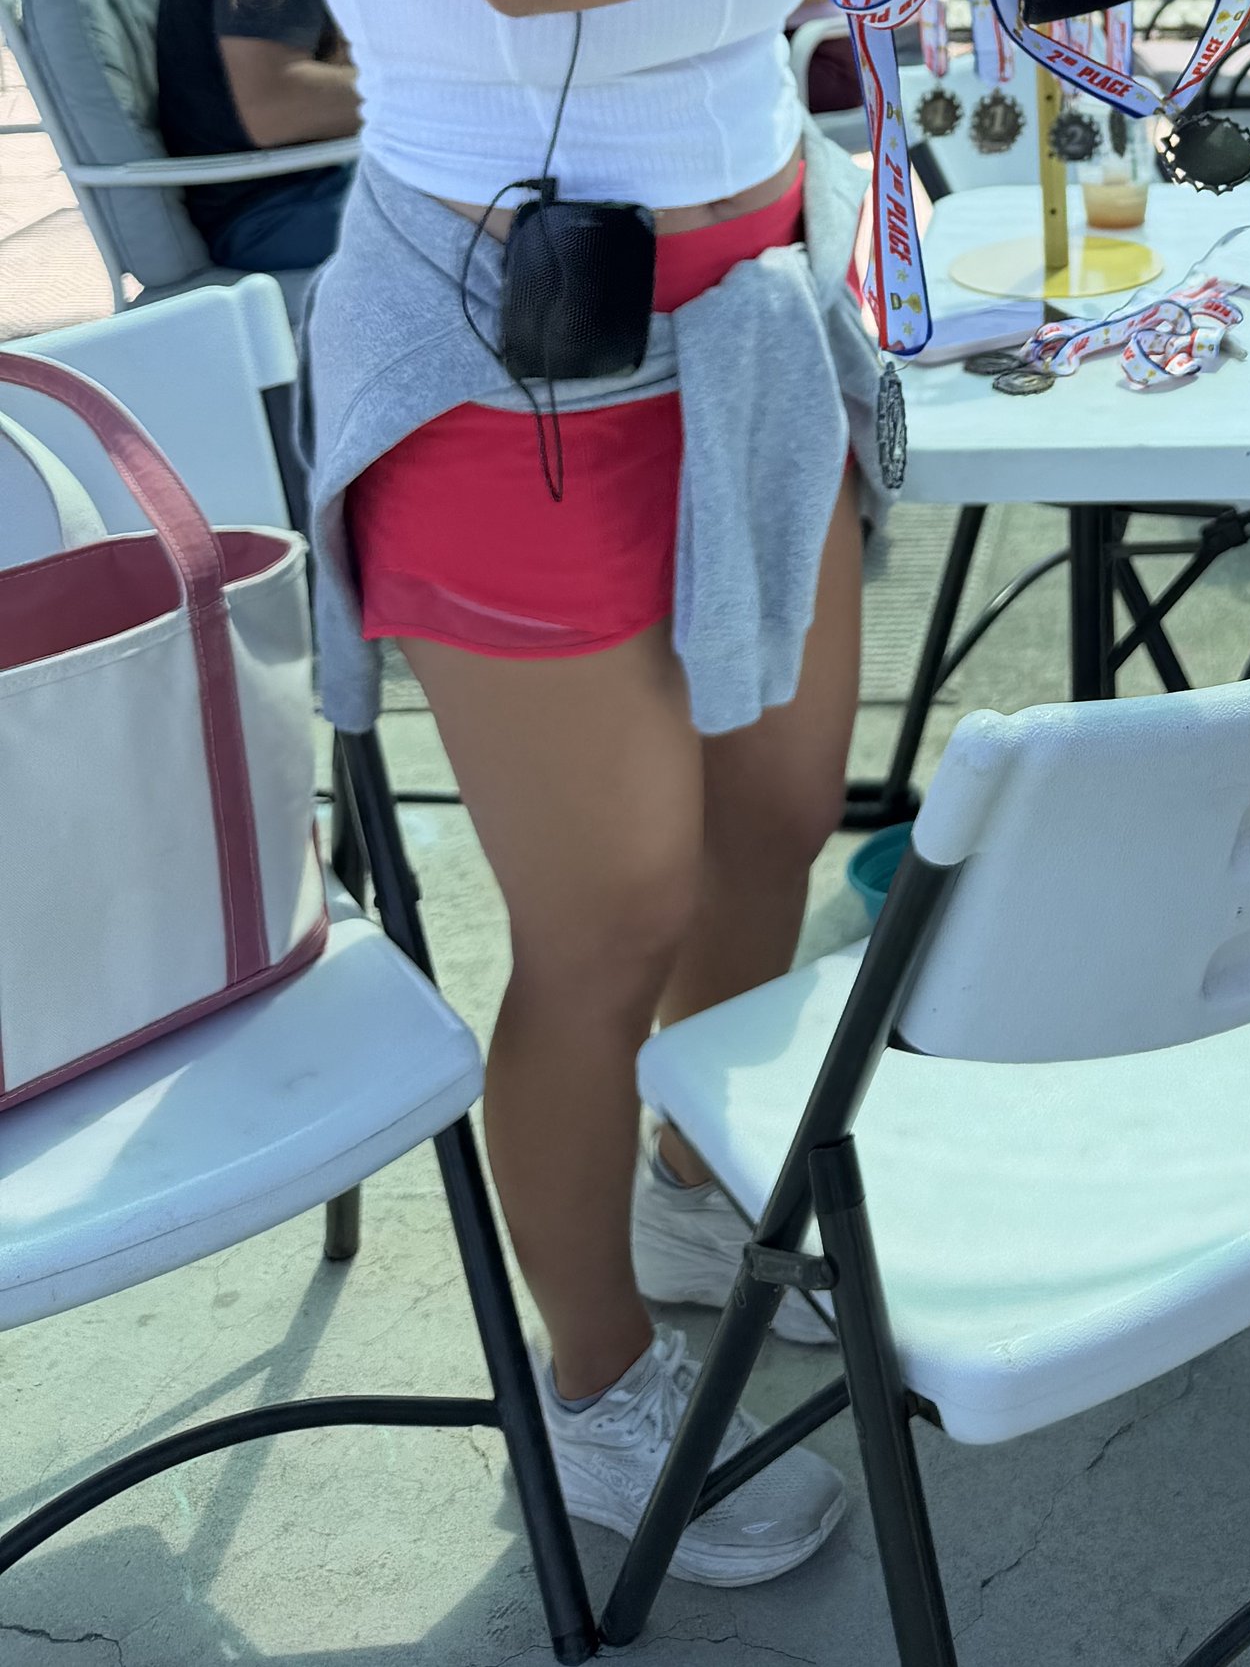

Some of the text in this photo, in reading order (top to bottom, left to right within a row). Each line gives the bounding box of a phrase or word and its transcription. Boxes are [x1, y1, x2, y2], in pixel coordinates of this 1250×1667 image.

[1076, 66, 1133, 97] PLACE
[1065, 124, 1084, 150] 2
[886, 193, 913, 266] PLACE
